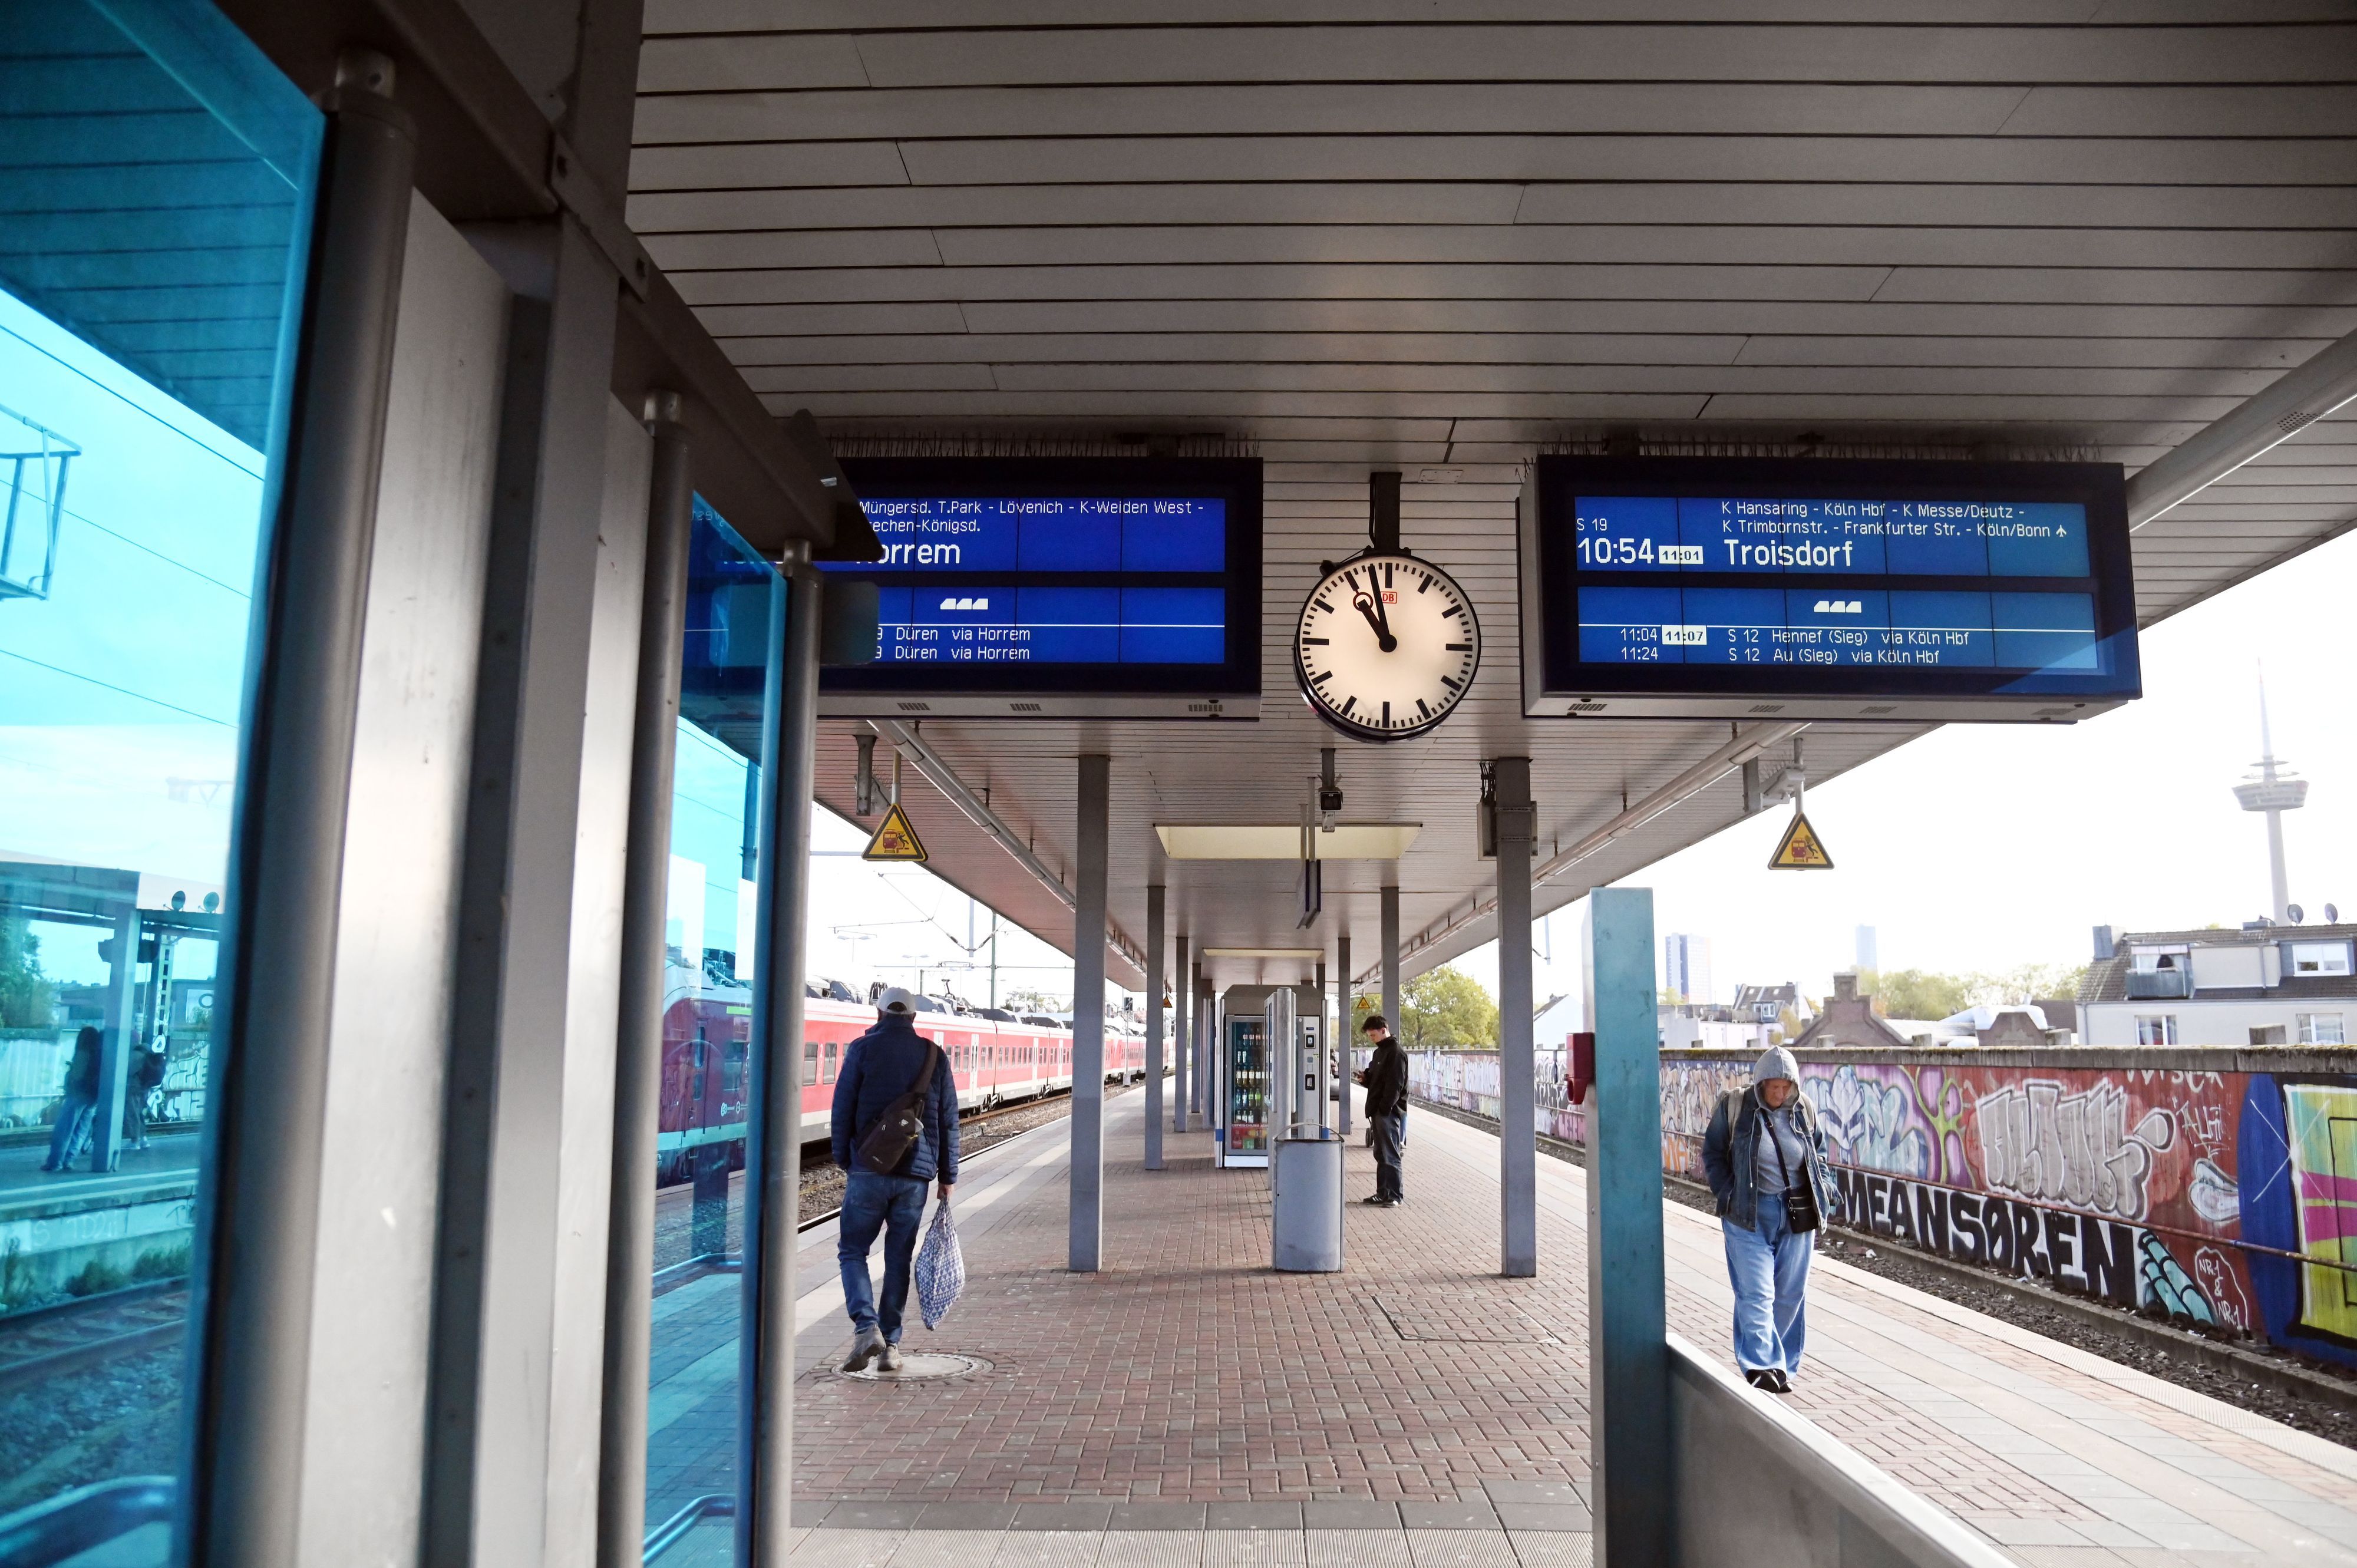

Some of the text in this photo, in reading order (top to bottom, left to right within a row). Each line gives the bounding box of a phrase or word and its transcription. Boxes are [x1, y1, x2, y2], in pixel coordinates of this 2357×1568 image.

[859, 501, 932, 516] Müngersd.
[938, 501, 982, 514] T.Park
[1000, 501, 1062, 514] Lövenich
[1080, 501, 1148, 514] K-Weiden
[1154, 501, 1192, 514] West
[1722, 501, 1731, 514] K
[1737, 501, 1807, 517] Hansaring
[1824, 503, 1856, 516] Köln
[1861, 503, 1886, 516] Hbf
[1903, 504, 1913, 517] K
[1918, 504, 2013, 519] Messe/Deutz
[869, 519, 981, 534] echen-Königsd.
[1577, 518, 1607, 531] S 19
[1722, 520, 1732, 533] K
[1738, 520, 1828, 534] Trimbornstr.
[1844, 521, 1928, 535] Frankfurter
[1934, 522, 1960, 536] Str.
[1977, 523, 2051, 537] Köln/Bonn
[856, 544, 960, 564] orrem
[1578, 537, 1700, 564] 10:54 11:01
[1724, 539, 1853, 566] Troisdorf
[896, 627, 938, 641] Düren
[952, 628, 972, 641] via
[978, 627, 1031, 641] Horrem
[1620, 628, 1704, 642] 11:04 11:07
[1728, 629, 1969, 646] S 12 Hennef (Sieg) via Köln Hbf
[895, 645, 937, 659] Düren
[951, 646, 972, 659] via
[978, 646, 1030, 659] Horrem
[1621, 647, 1658, 661] 11:24
[1729, 648, 1940, 665] S 12 Au (Sieg) via Köln Hbf
[2199, 1259, 2220, 1277] NR.1
[2217, 1300, 2243, 1329] NR.1
